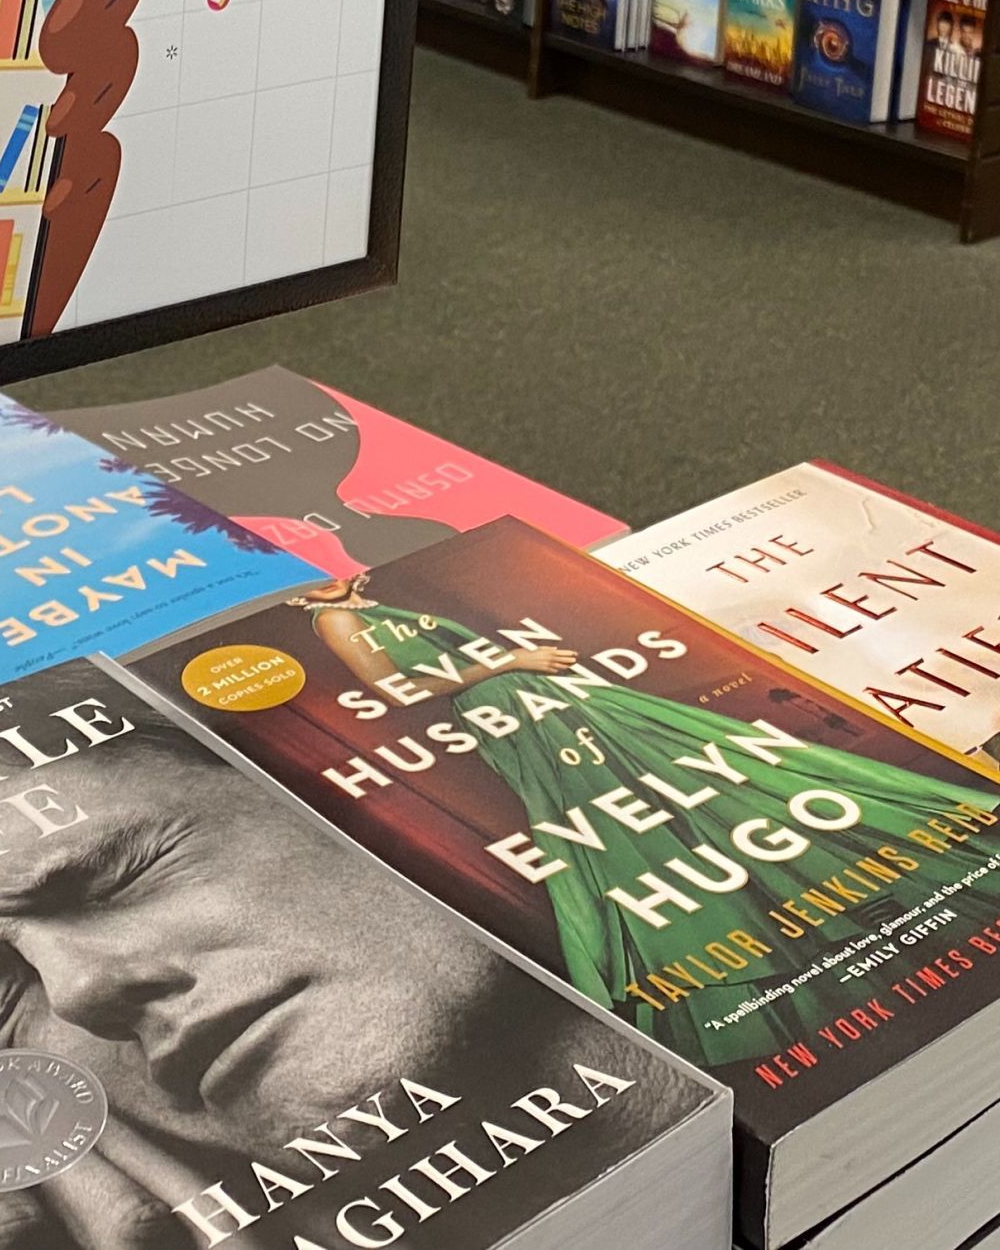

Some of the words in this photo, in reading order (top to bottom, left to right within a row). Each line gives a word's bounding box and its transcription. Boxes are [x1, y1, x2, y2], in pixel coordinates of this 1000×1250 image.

[102, 402, 275, 452] HUMAN
[294, 410, 358, 446] NO
[144, 434, 292, 485] LONGE
[618, 554, 650, 576] NEW
[650, 536, 692, 563] YORK
[692, 518, 733, 543] TIMES
[731, 486, 808, 525] BESTSELLER
[14, 545, 95, 590] IN
[705, 533, 815, 584] THE
[756, 540, 978, 655] ILENT
[350, 613, 438, 654] The
[196, 683, 212, 699] 2
[211, 655, 287, 694] MILLION
[210, 655, 245, 676] OVER
[217, 682, 262, 708] COPIES
[261, 666, 298, 689] SOLD
[336, 616, 563, 720] SEVEN
[698, 693, 709, 704] a
[710, 670, 753, 699] novel
[863, 618, 1000, 729] ATIE
[321, 629, 688, 799] HUSBANDS
[558, 726, 606, 767] of
[485, 718, 808, 885] EVELYN
[605, 788, 862, 930] HUGO
[625, 927, 773, 1011] TAYLOR
[768, 844, 920, 940] JENKINS
[907, 801, 999, 854] REID
[898, 906, 959, 947] GIFFIN
[722, 980, 796, 1025] spellbinding
[791, 962, 825, 987] novel
[822, 945, 854, 970] about
[850, 930, 883, 952] love,
[878, 905, 927, 937] glamour,
[923, 891, 946, 909] and
[942, 880, 964, 897] the
[960, 864, 990, 889] price
[987, 854, 1000, 871] of
[754, 1040, 819, 1090] NEW
[817, 997, 897, 1050] YORK
[890, 948, 975, 1005] TIMES
[967, 920, 1000, 956] BE
[27, 1057, 95, 1104] AWARD
[1, 1119, 93, 1184] FINALIST
[171, 1076, 463, 1250] HANYA
